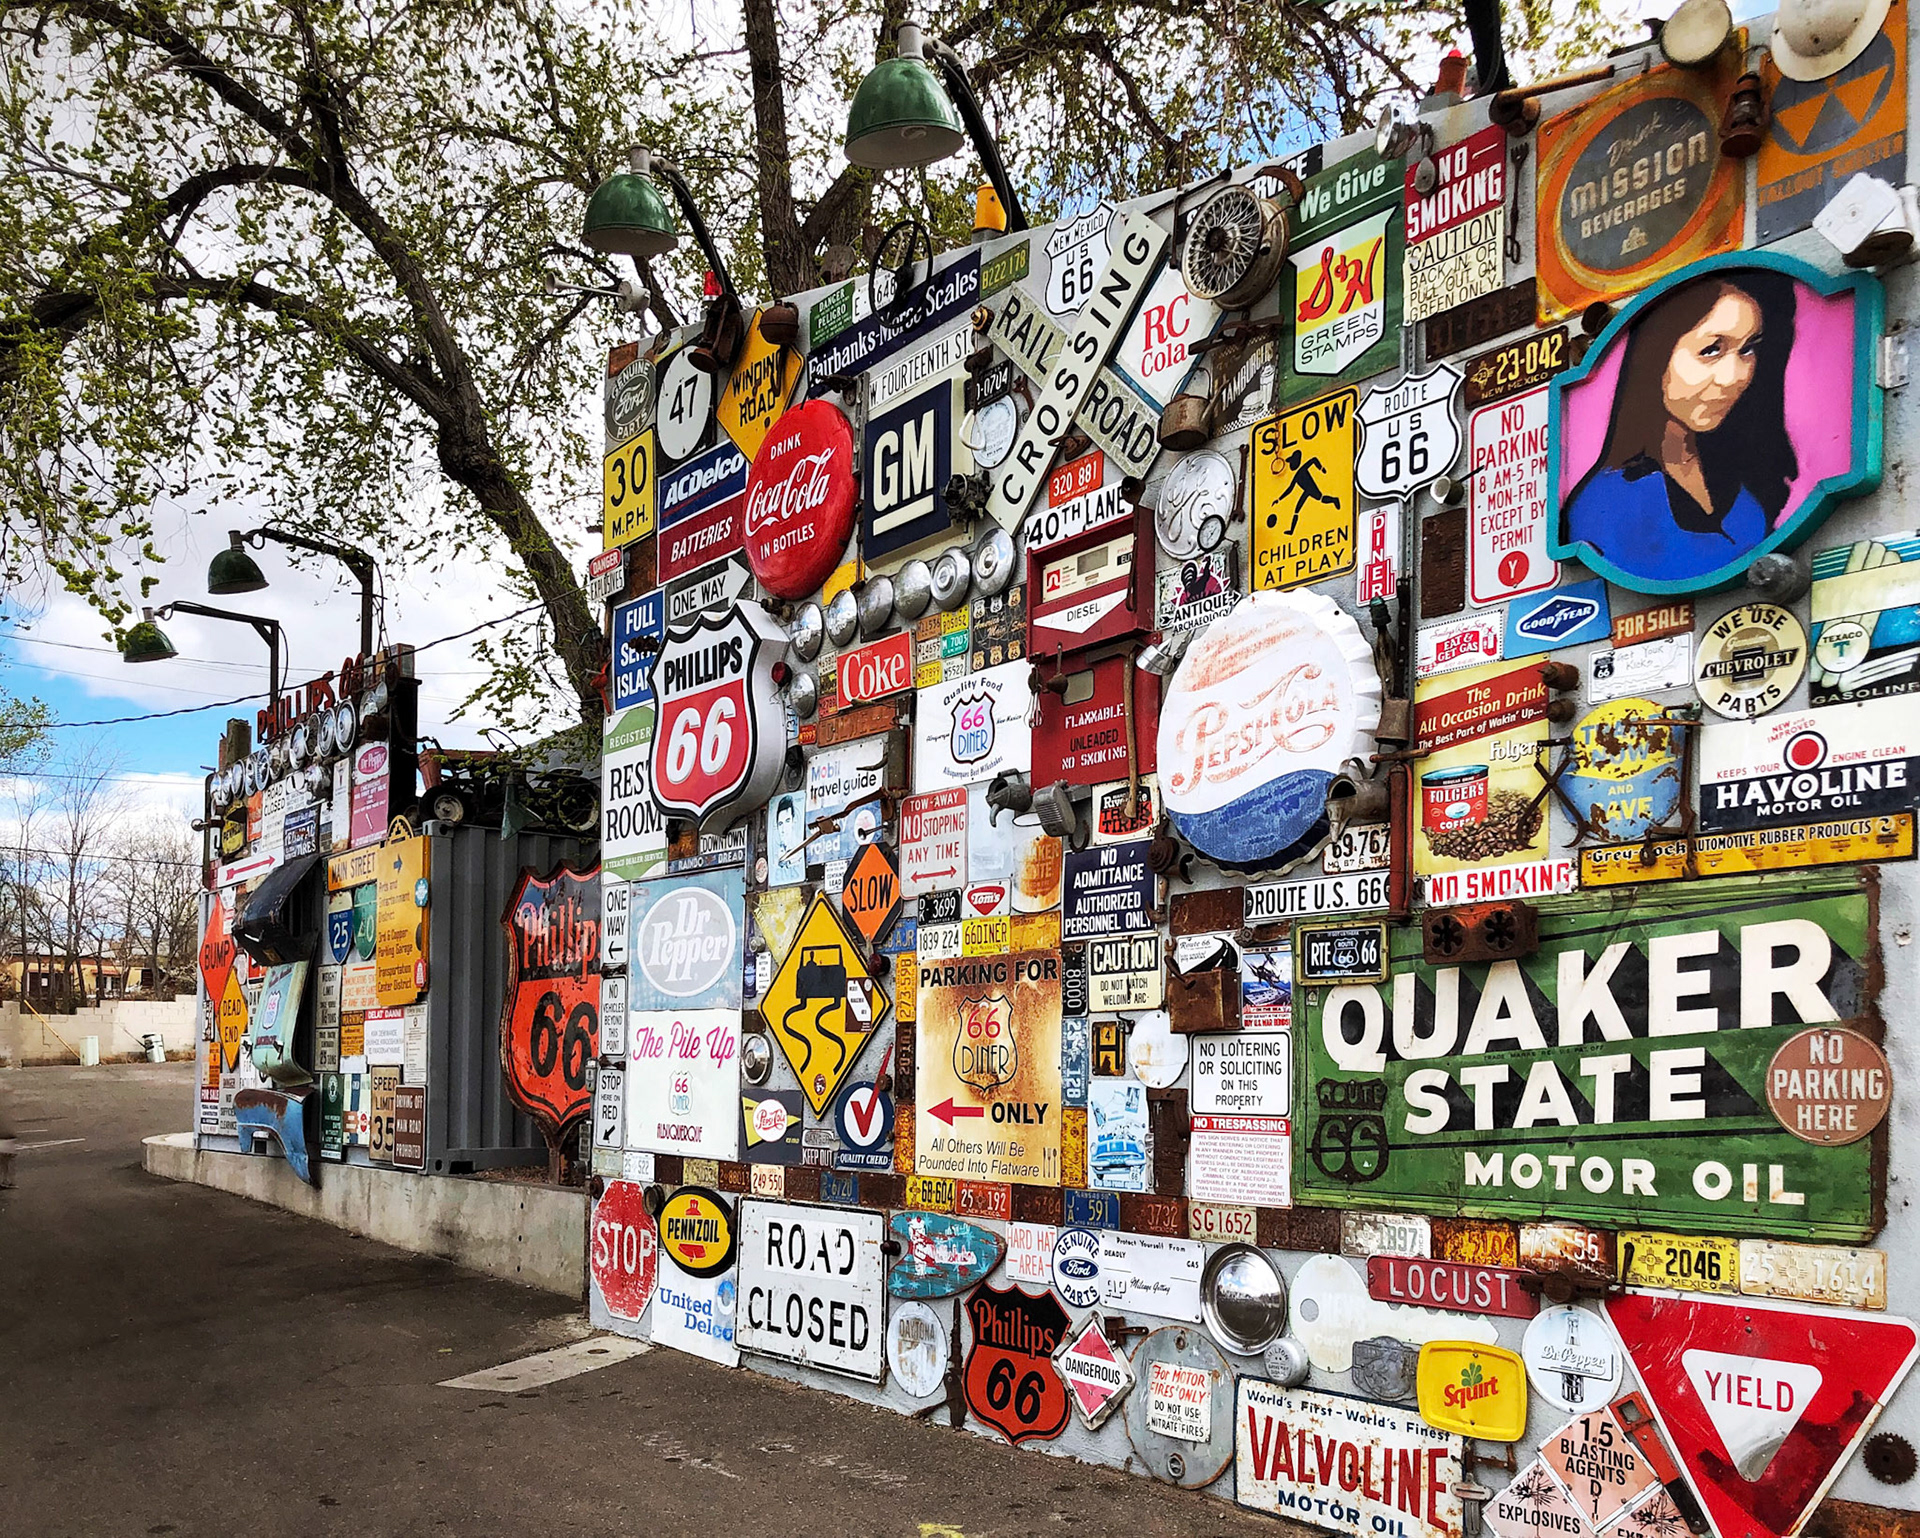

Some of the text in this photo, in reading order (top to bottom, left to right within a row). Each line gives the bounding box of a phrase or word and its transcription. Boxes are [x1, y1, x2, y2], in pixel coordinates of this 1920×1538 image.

[1569, 131, 1709, 219] MISSION
[1300, 163, 1387, 224] We Give
[1407, 163, 1502, 240] SMOKING
[1062, 259, 1094, 304] 66
[1142, 295, 1190, 352] RC
[1481, 371, 1548, 400] NEW MEXICO
[668, 375, 700, 424] 47
[1261, 398, 1351, 457] SLOW
[1501, 404, 1524, 436] NO
[874, 408, 934, 513] GM
[1381, 431, 1429, 484] 66
[609, 441, 647, 507] 30
[1052, 463, 1098, 498] 320 881
[1488, 480, 1538, 512] MON-FRI
[671, 517, 733, 562] BATTERIES
[1258, 525, 1349, 568] CHILDREN
[1492, 525, 1534, 554] PERMIT
[672, 576, 726, 616] ONE WAY
[626, 602, 656, 634] FULL
[1067, 602, 1101, 622] DIESEL
[1822, 631, 1863, 644] TEXACO
[1437, 639, 1479, 661] GET GAS
[664, 636, 742, 696] PHILLIPS
[842, 648, 906, 702] Coke
[1706, 651, 1792, 678] CHEVROLET
[942, 676, 1003, 706] Quality Food
[1466, 686, 1491, 704] The
[961, 704, 984, 730] 66
[666, 704, 736, 784] 66
[1832, 746, 1906, 763] ENGINE CLEAN
[1062, 746, 1127, 770] NO SMOKING
[811, 762, 840, 780] Mobil
[1716, 763, 1780, 779] KEEPS YOUR
[265, 784, 283, 801] ROAD
[810, 771, 877, 799] travel guide
[1608, 783, 1634, 796] AND
[1716, 761, 1907, 810] HAVOLINE
[263, 798, 286, 816] CLOSED
[910, 792, 959, 811] TOW-AWAY
[1756, 794, 1862, 817] MOTOR OIL
[902, 812, 965, 838] NO STOPPING
[1759, 828, 1805, 844] RUBBER
[1809, 820, 1872, 838] PRODUCTS
[908, 842, 960, 864] ANY TIME
[1100, 849, 1116, 865] NO
[332, 851, 376, 884] MAIN STREET
[1074, 863, 1144, 888] ADMITTANCE
[606, 890, 627, 911] ONE
[850, 875, 893, 914] SLOW
[971, 891, 1000, 905] Tom's
[1075, 892, 1141, 913] AUTHORIZED
[333, 922, 348, 950] 25
[606, 916, 626, 937] WAY
[378, 943, 413, 958] Parking Garage
[920, 930, 959, 950] 1839 224
[204, 940, 230, 970] BUMP
[1092, 944, 1156, 970] CAUTION
[1338, 953, 1354, 964] 66
[378, 964, 411, 979] Transportation
[920, 958, 1058, 988] PARKING FOR
[322, 983, 334, 997] LIMIT
[378, 978, 412, 993] Center District
[608, 981, 618, 992] NO
[1322, 918, 1841, 1073] QUAKER
[223, 998, 241, 1016] DEAD
[603, 1002, 624, 1013] VEHICLES
[604, 1015, 623, 1026] BEYOND
[967, 1007, 1000, 1039] 66
[225, 1025, 239, 1043] END
[608, 1028, 619, 1038] THIS
[633, 1021, 736, 1068] The Pile Up
[962, 1044, 1010, 1076] DINER
[1200, 1042, 1281, 1058] NO LOITERING
[1199, 1061, 1282, 1076] OR SOLICITING
[601, 1074, 621, 1092] STOP
[674, 1078, 688, 1094] 66
[1221, 1080, 1258, 1091] ON THIS
[1403, 1047, 1706, 1136] STATE
[1773, 1067, 1884, 1101] PARKING
[396, 1094, 423, 1109] DRIVING OFF
[602, 1104, 618, 1120] RED
[991, 1102, 1048, 1124] ONLY
[1215, 1095, 1263, 1107] PROPERTY
[396, 1118, 421, 1133] MAIN ROAD
[1194, 1118, 1286, 1132] NO TRESPASSING
[395, 1142, 422, 1159] PROHIBITED
[802, 1148, 833, 1167] KEEP OUT
[931, 1138, 1025, 1157] All Others Will Be
[918, 1154, 1040, 1178] Pounded Into Flatware
[753, 1175, 783, 1193] 249 550
[1464, 1152, 1806, 1206] MOTOR OIL
[961, 1188, 1007, 1211] 25 192
[667, 1218, 720, 1243] PENNZOIL
[596, 1222, 653, 1276] STOP
[1104, 1249, 1126, 1259] DEADLY
[1018, 1259, 1045, 1277] AREA
[1066, 1258, 1091, 1276] Ford
[1187, 1260, 1199, 1269] GAS
[1388, 1261, 1511, 1310] LOCUST
[1640, 1275, 1719, 1290] NEW MEXICO
[659, 1288, 713, 1316] United
[1062, 1285, 1099, 1306] PARTS
[749, 1286, 869, 1352] CLOSED
[973, 1300, 1055, 1360] Phillips
[1065, 1357, 1121, 1385] DANGEROUS
[1152, 1365, 1205, 1388] For MOTOR
[987, 1358, 1046, 1424] 66
[1704, 1369, 1795, 1413] YIELD
[1154, 1400, 1199, 1419] DO NOT USE
[1247, 1405, 1449, 1534] VALVOLINE
